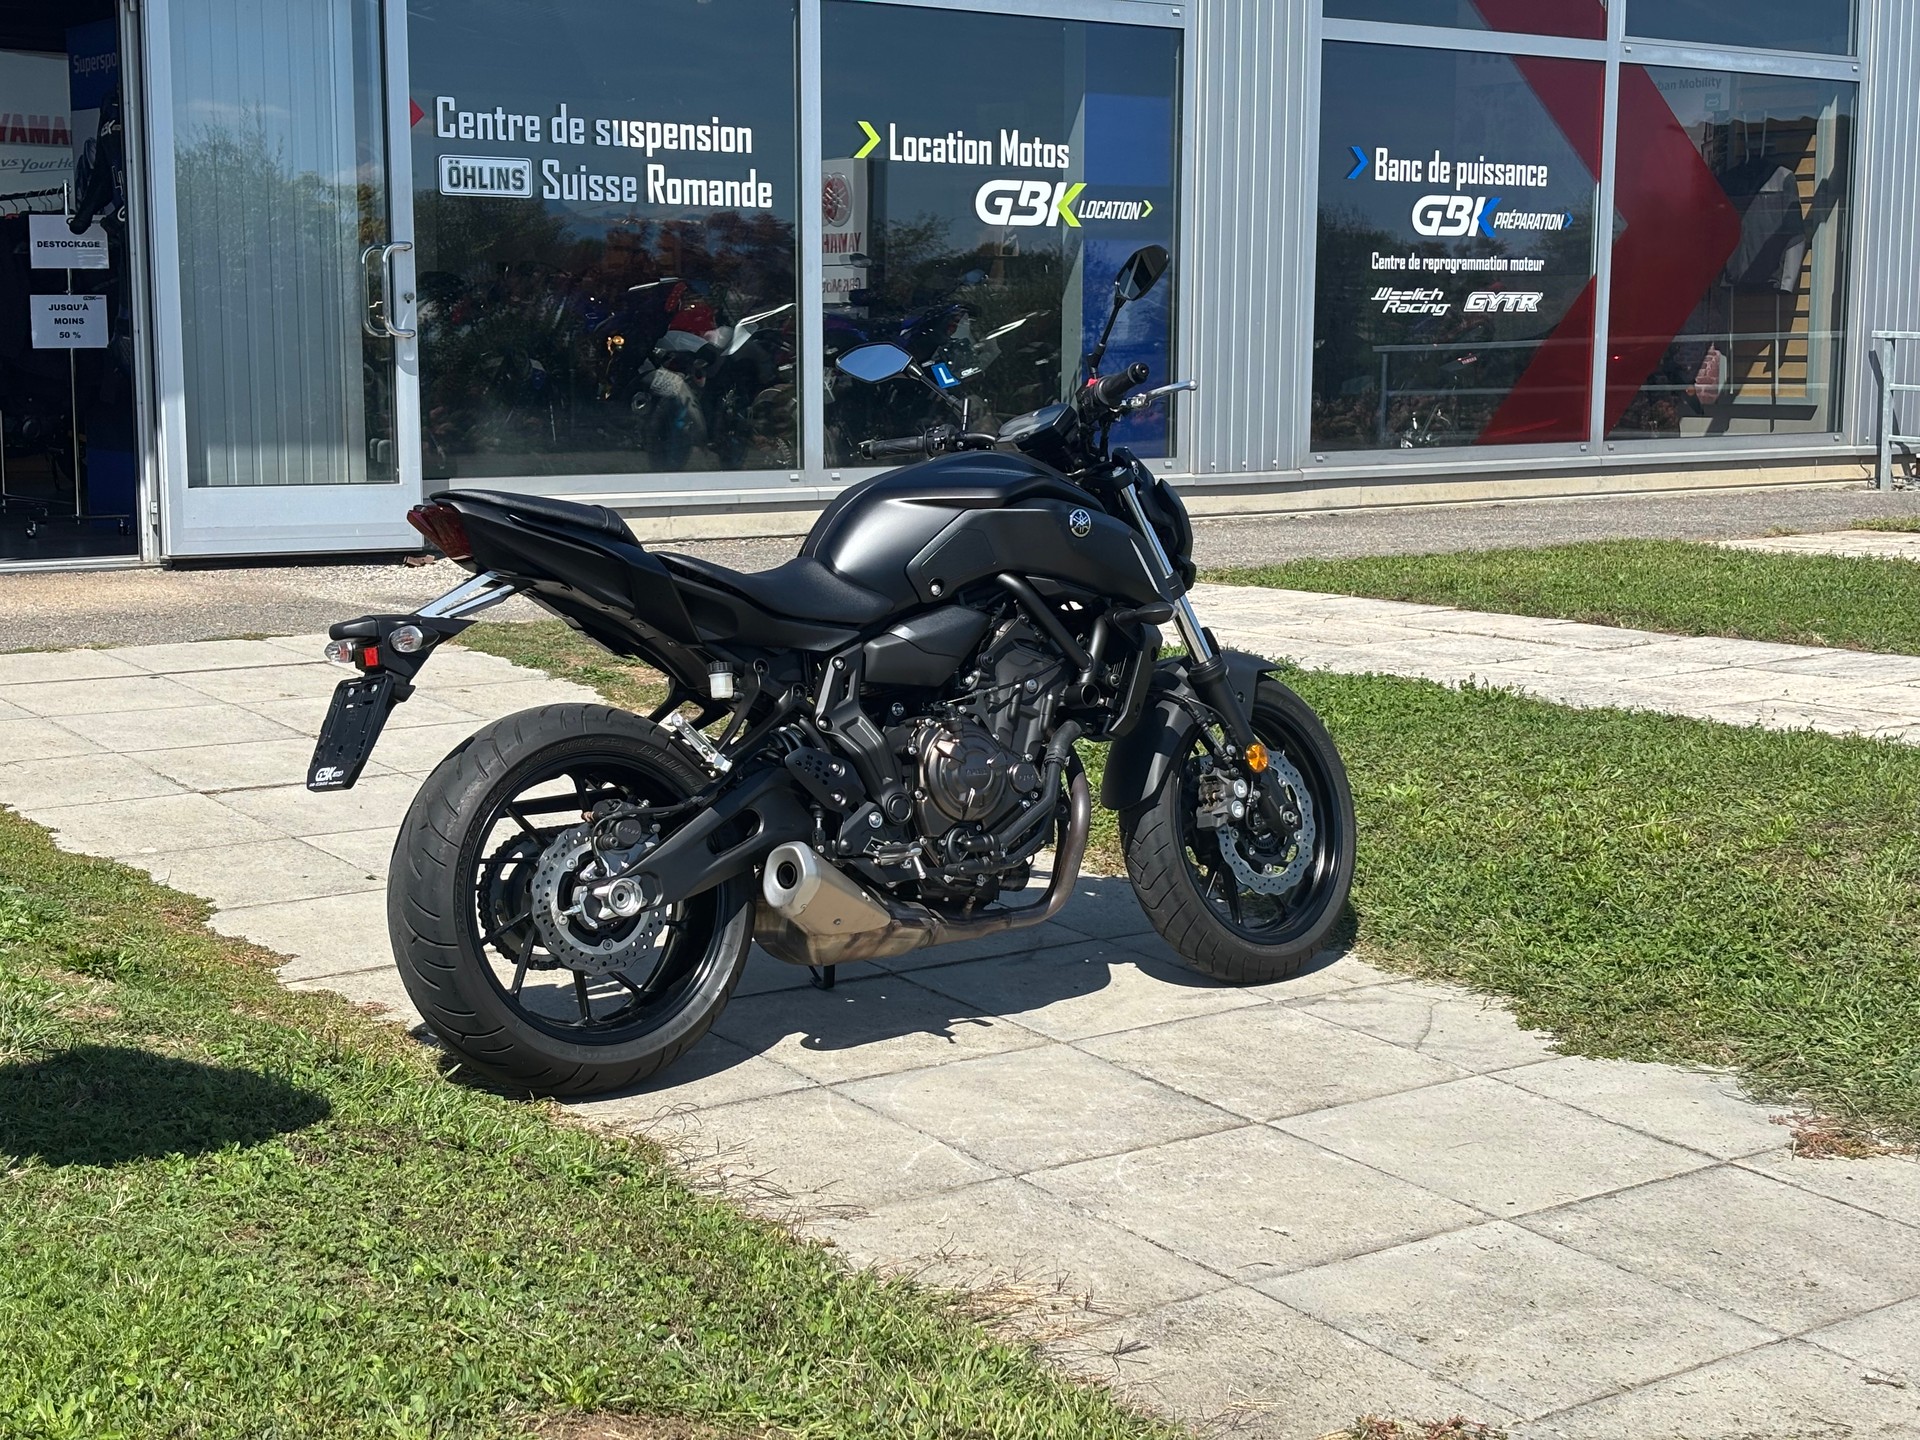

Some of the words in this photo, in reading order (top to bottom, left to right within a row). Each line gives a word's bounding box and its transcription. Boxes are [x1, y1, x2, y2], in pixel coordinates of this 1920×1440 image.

[1679, 76, 1722, 90] Mobility
[0, 113, 72, 146] YAMA
[436, 96, 541, 143] Centre
[551, 103, 585, 145] de
[596, 117, 752, 157] suspension
[889, 122, 992, 165] Location
[1000, 128, 1070, 169] Motos
[20, 158, 57, 174] Your
[1374, 147, 1422, 183] Banc
[1428, 150, 1451, 185] de
[1456, 156, 1548, 191] puissance
[448, 159, 528, 191] ÖHLINS
[542, 159, 638, 203] Suisse
[647, 163, 773, 208] Romande
[975, 179, 1087, 227] GBK
[1078, 200, 1143, 220] LOCATION
[1411, 194, 1502, 238] GBK
[1493, 209, 1565, 231] PRÉPARATION
[37, 240, 100, 248] DESTOCKAGE
[1371, 252, 1405, 271] Centre
[1408, 253, 1421, 271] de
[1423, 255, 1508, 274] reprogrammation
[1510, 257, 1545, 272] moteur
[1371, 287, 1444, 301] Woolich
[1463, 291, 1544, 312] GYTR
[48, 303, 89, 311] JUSQU'À
[1382, 300, 1451, 316] Racing
[54, 317, 85, 325] MOINS
[59, 331, 70, 339] 50
[73, 331, 81, 339] %
